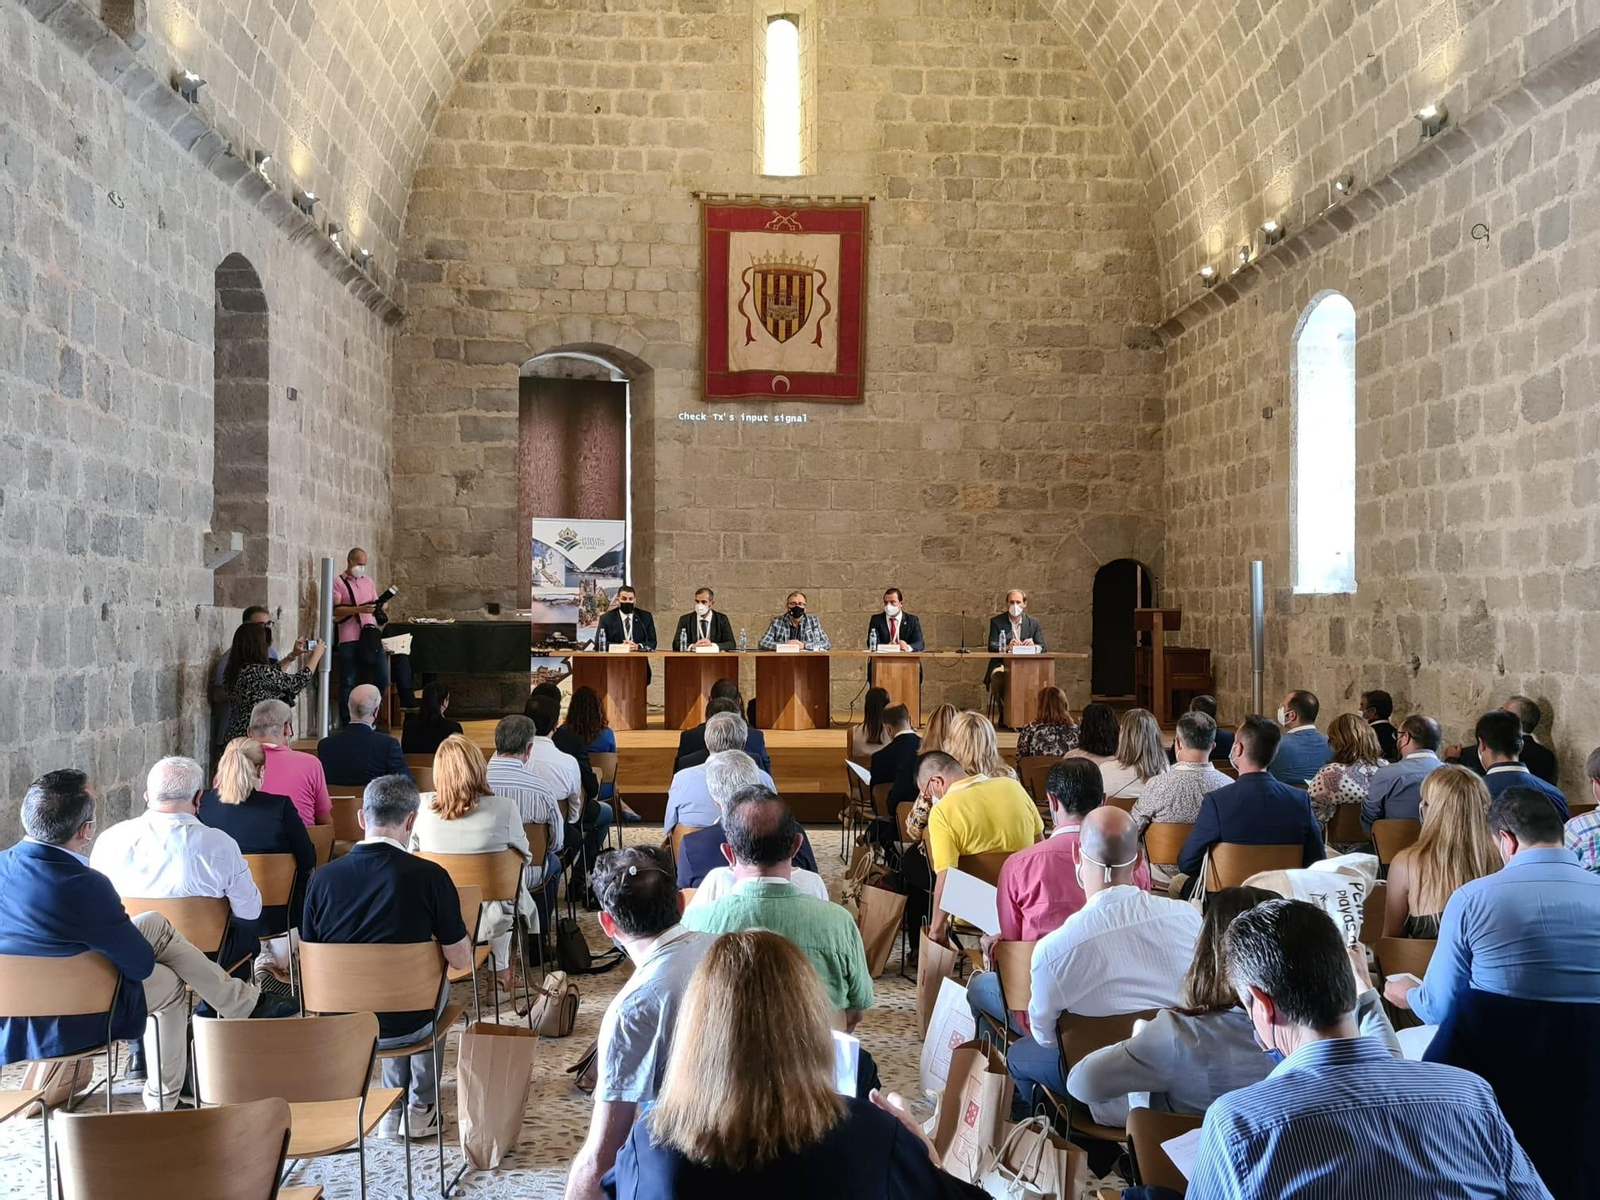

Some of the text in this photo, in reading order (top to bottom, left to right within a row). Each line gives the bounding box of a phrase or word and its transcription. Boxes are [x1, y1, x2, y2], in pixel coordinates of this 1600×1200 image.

[678, 412, 807, 424] Check Tx's input signal
